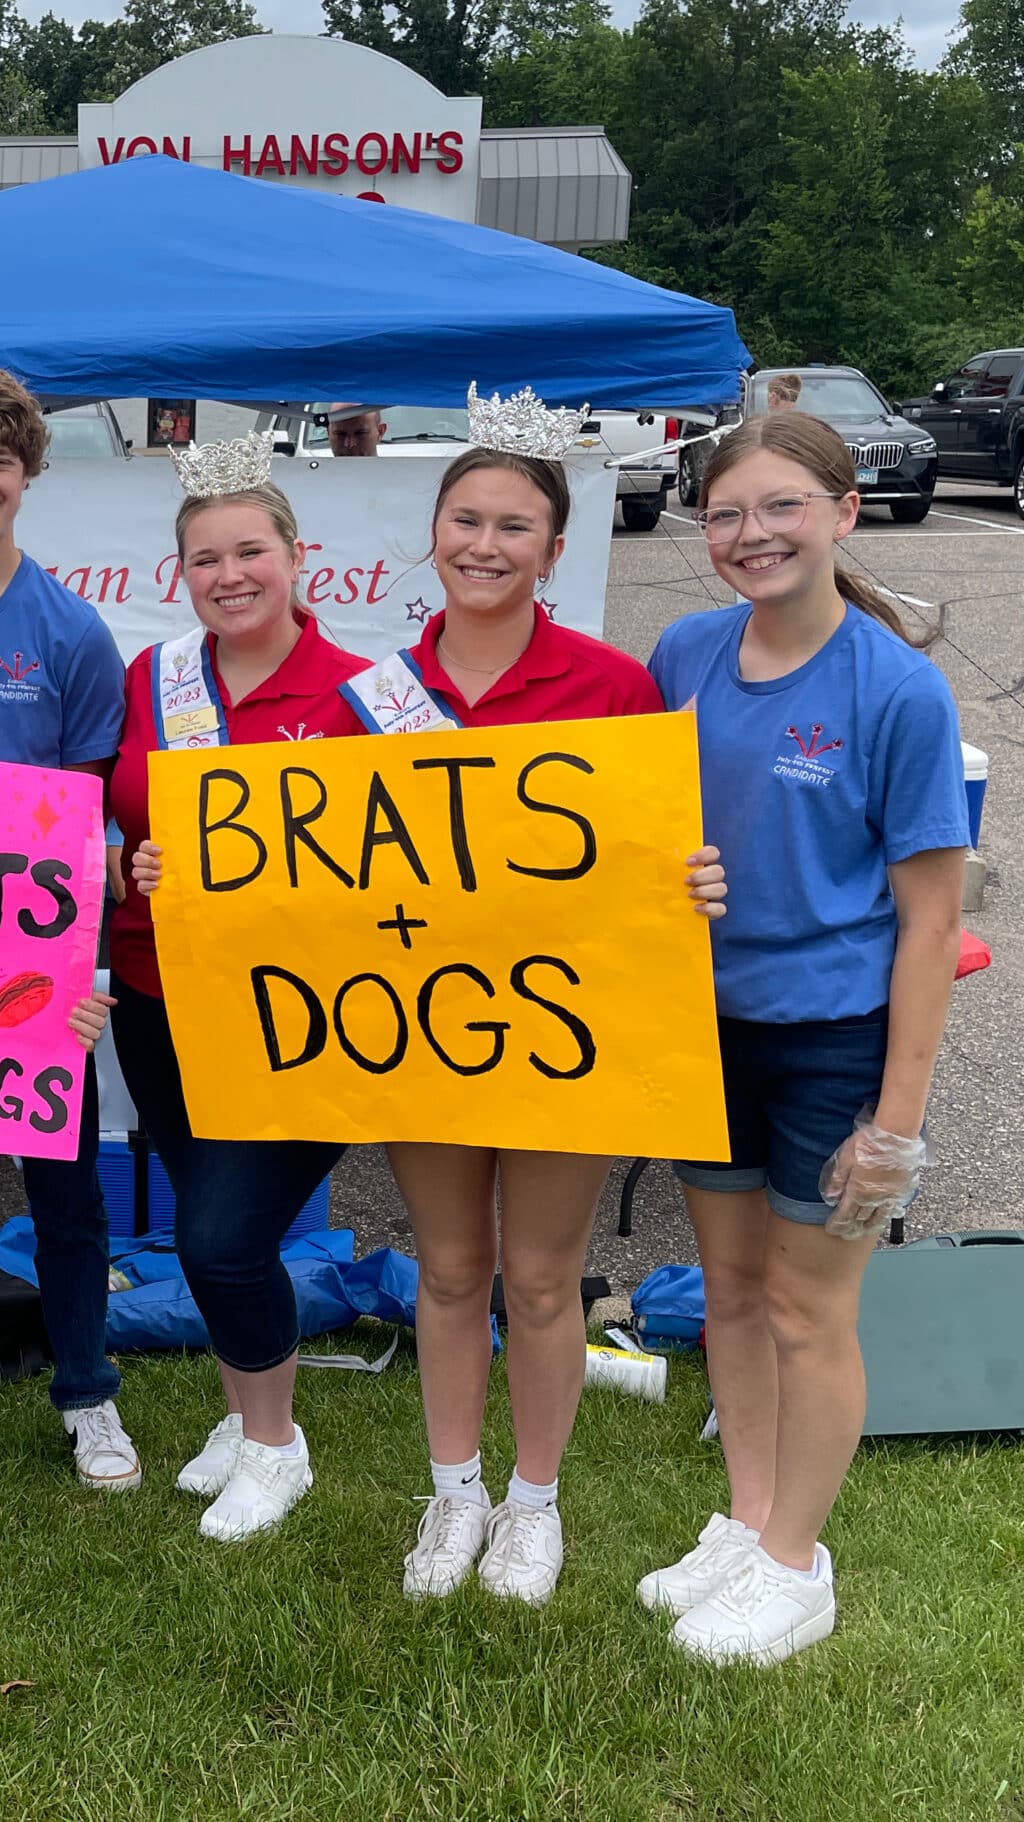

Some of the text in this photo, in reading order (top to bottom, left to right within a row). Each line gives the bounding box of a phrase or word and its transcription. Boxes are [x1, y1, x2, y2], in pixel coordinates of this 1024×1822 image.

[97, 131, 464, 176] VON HANSON'S
[44, 565, 132, 604] an
[166, 686, 201, 710] 2023
[772, 764, 832, 787] CANDIDATE
[198, 751, 597, 893] BRATS
[250, 954, 597, 1080] DOGS
